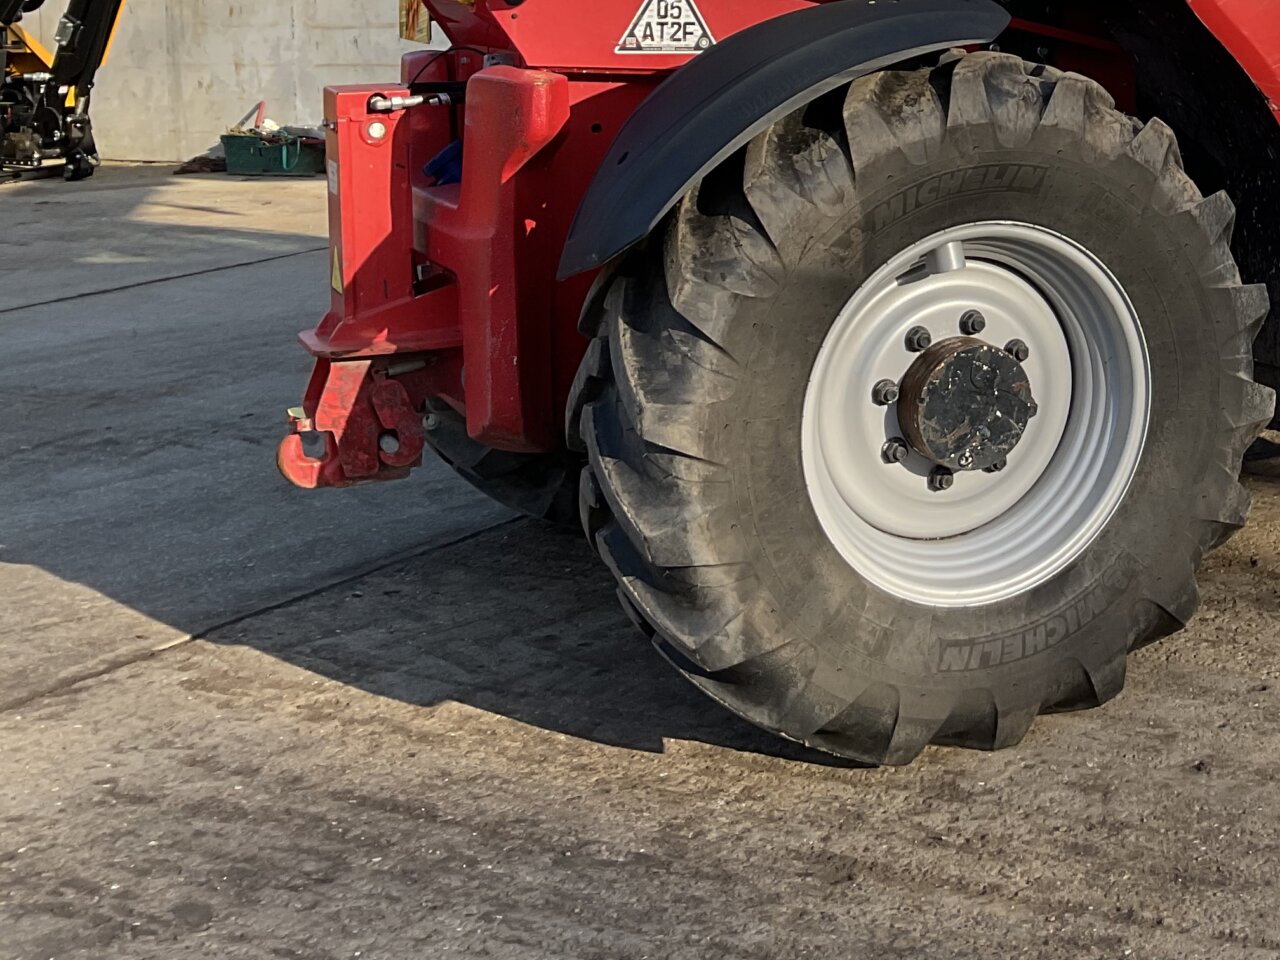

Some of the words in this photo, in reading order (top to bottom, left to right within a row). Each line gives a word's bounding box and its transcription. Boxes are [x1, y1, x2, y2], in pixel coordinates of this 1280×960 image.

[656, 0, 682, 19] D5
[641, 21, 695, 42] AT2F
[873, 165, 1045, 230] MICHELIN
[940, 588, 1108, 672] MICHELIN
